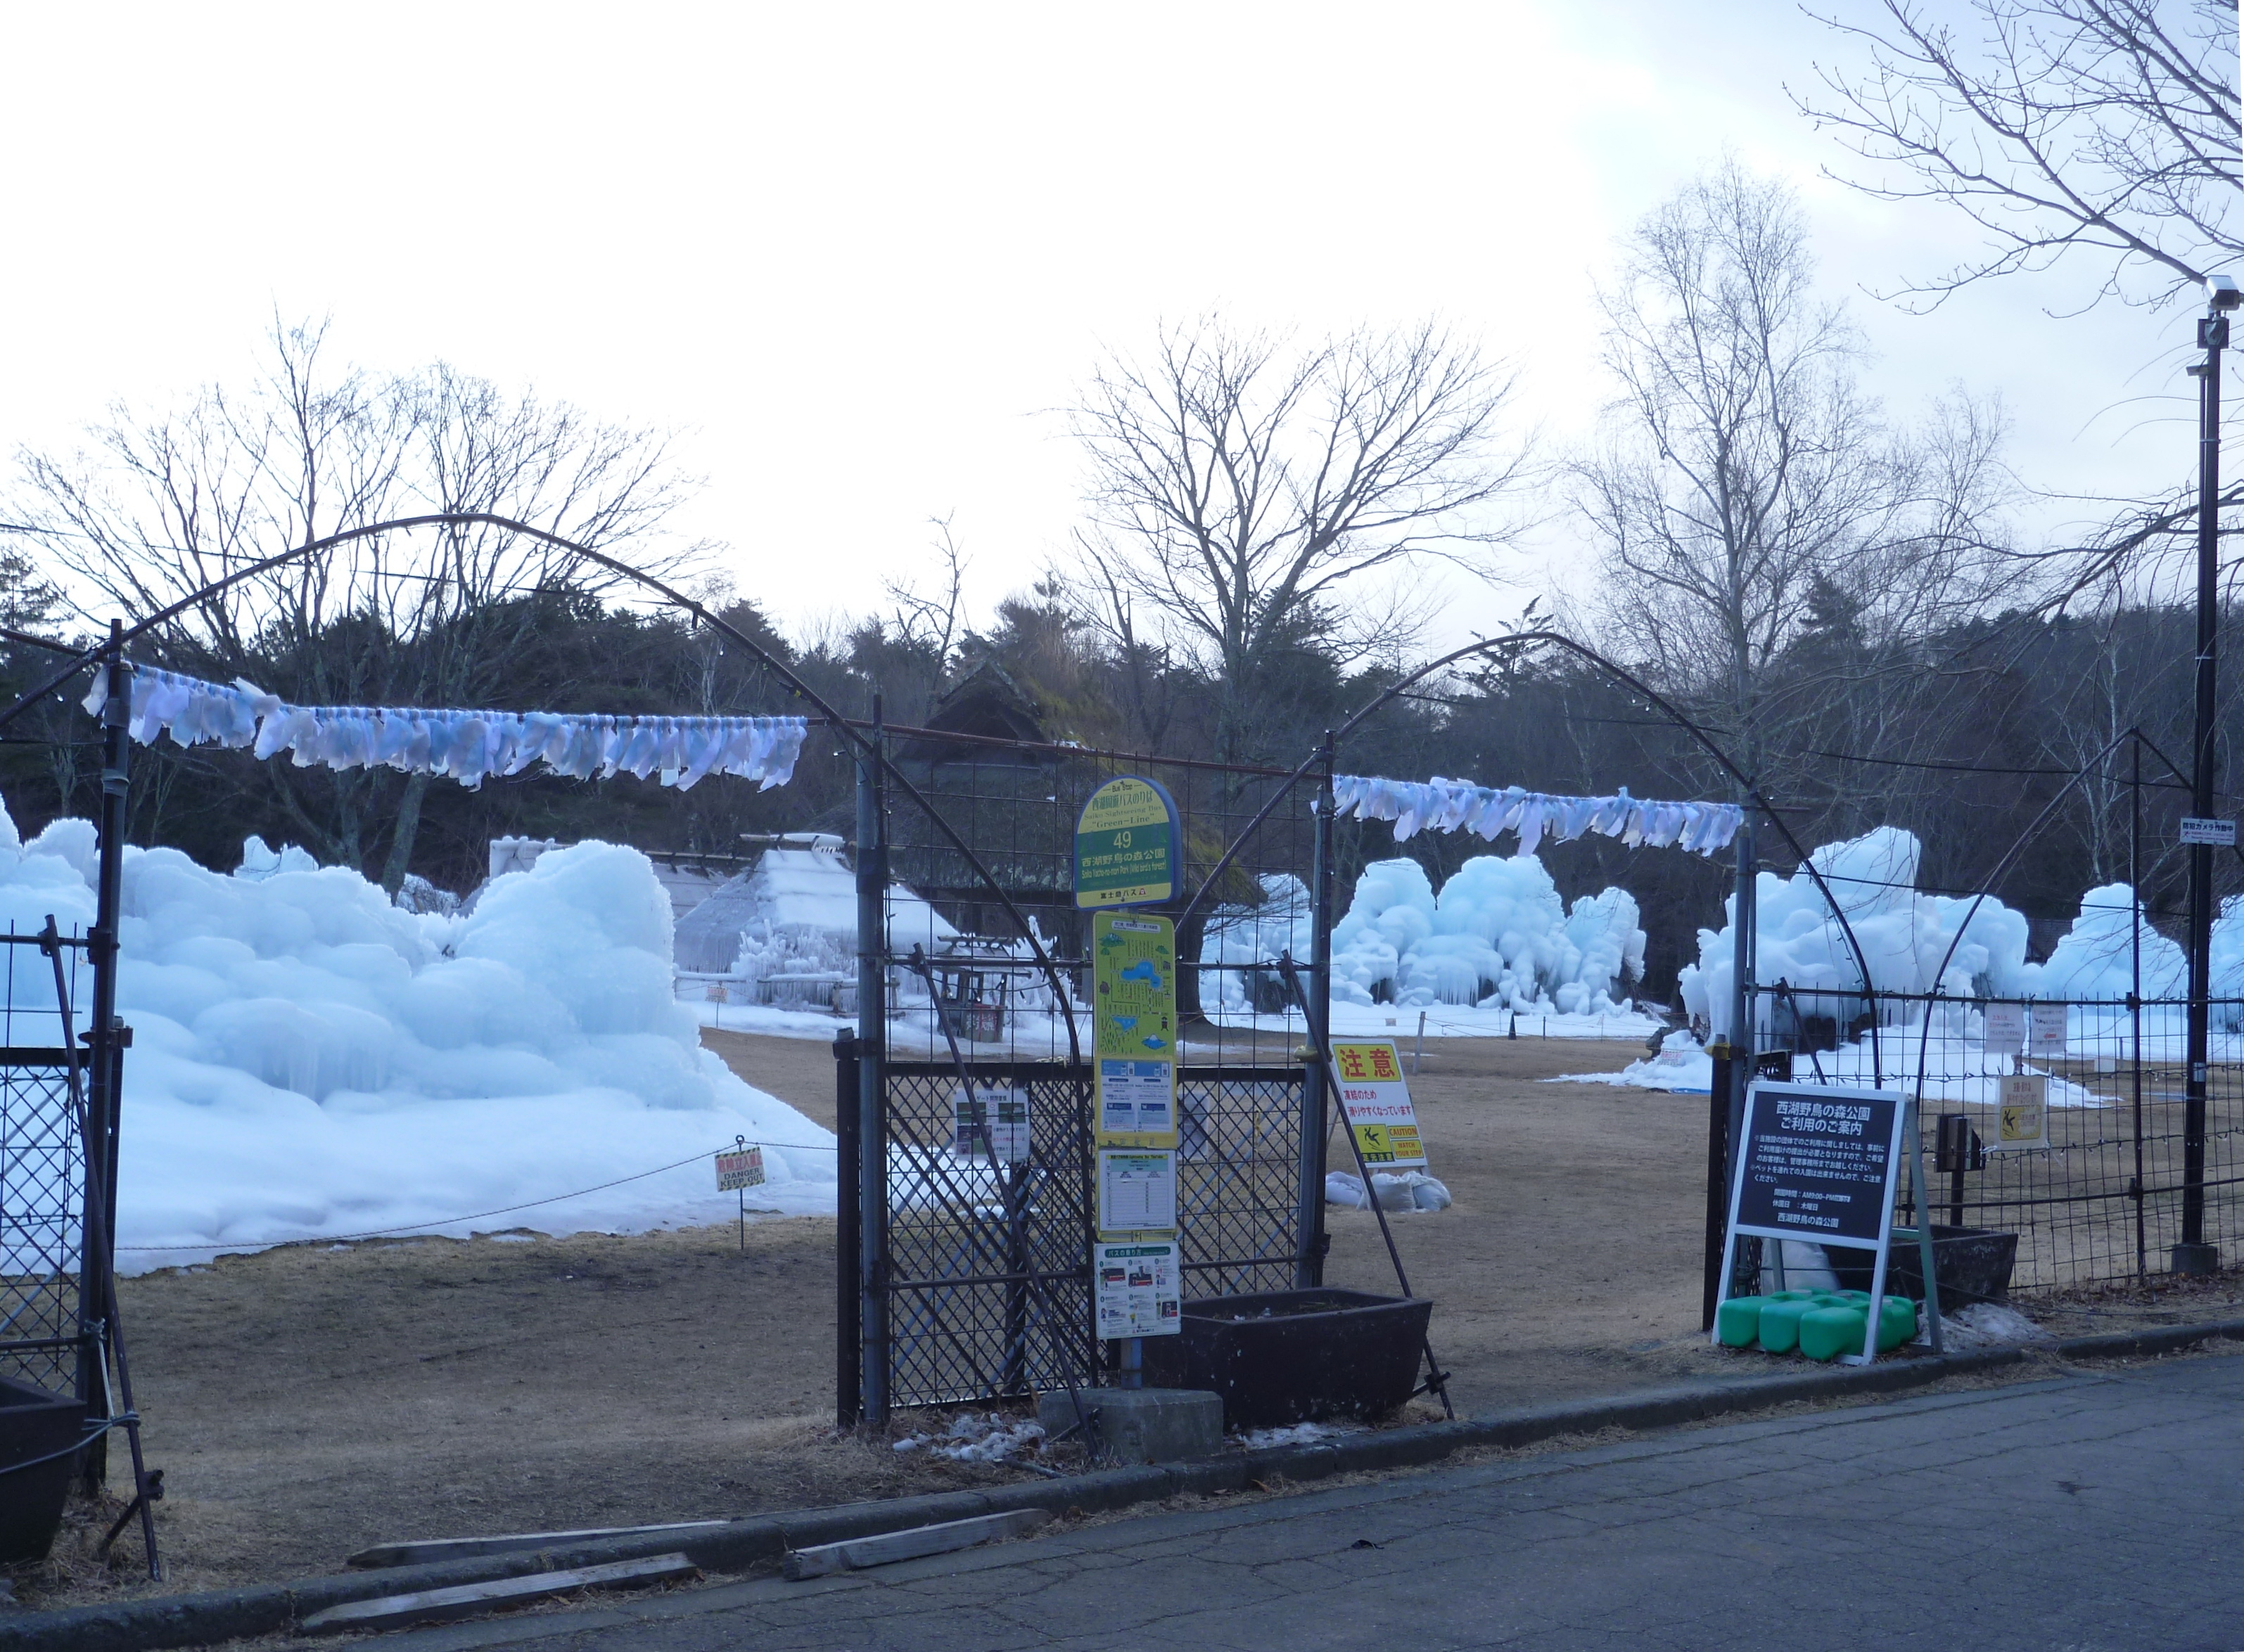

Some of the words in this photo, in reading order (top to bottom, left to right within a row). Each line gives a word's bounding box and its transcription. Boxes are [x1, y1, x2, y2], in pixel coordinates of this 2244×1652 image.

[1105, 807, 1146, 817] Sightseeing
[2182, 822, 2233, 832] 防犯カメラ作動中
[1114, 831, 1132, 849] 49
[1082, 848, 1166, 867] 西湖野鳥の森公園
[1100, 889, 1137, 899] 富士急バス
[1339, 1048, 1396, 1078] 注意
[1344, 1089, 1377, 1101] 凍結のため
[1347, 1105, 1411, 1118] 滑りやすくなっています
[1776, 1101, 1870, 1121] 西湖野鳥の森公園
[1389, 1127, 1417, 1136] CAUTION
[1781, 1117, 1863, 1136] ご利用のご案内
[1363, 1153, 1393, 1162] 足元注意
[724, 1167, 760, 1180] DANGER
[1754, 1174, 1778, 1184] ください。
[720, 1177, 744, 1188] KEEP
[747, 1173, 763, 1182] OUT
[1772, 1199, 1790, 1209] 休園日
[1777, 1212, 1840, 1229] 西湖野鳥の森公園
[1108, 1248, 1142, 1257] バスの乗り方
